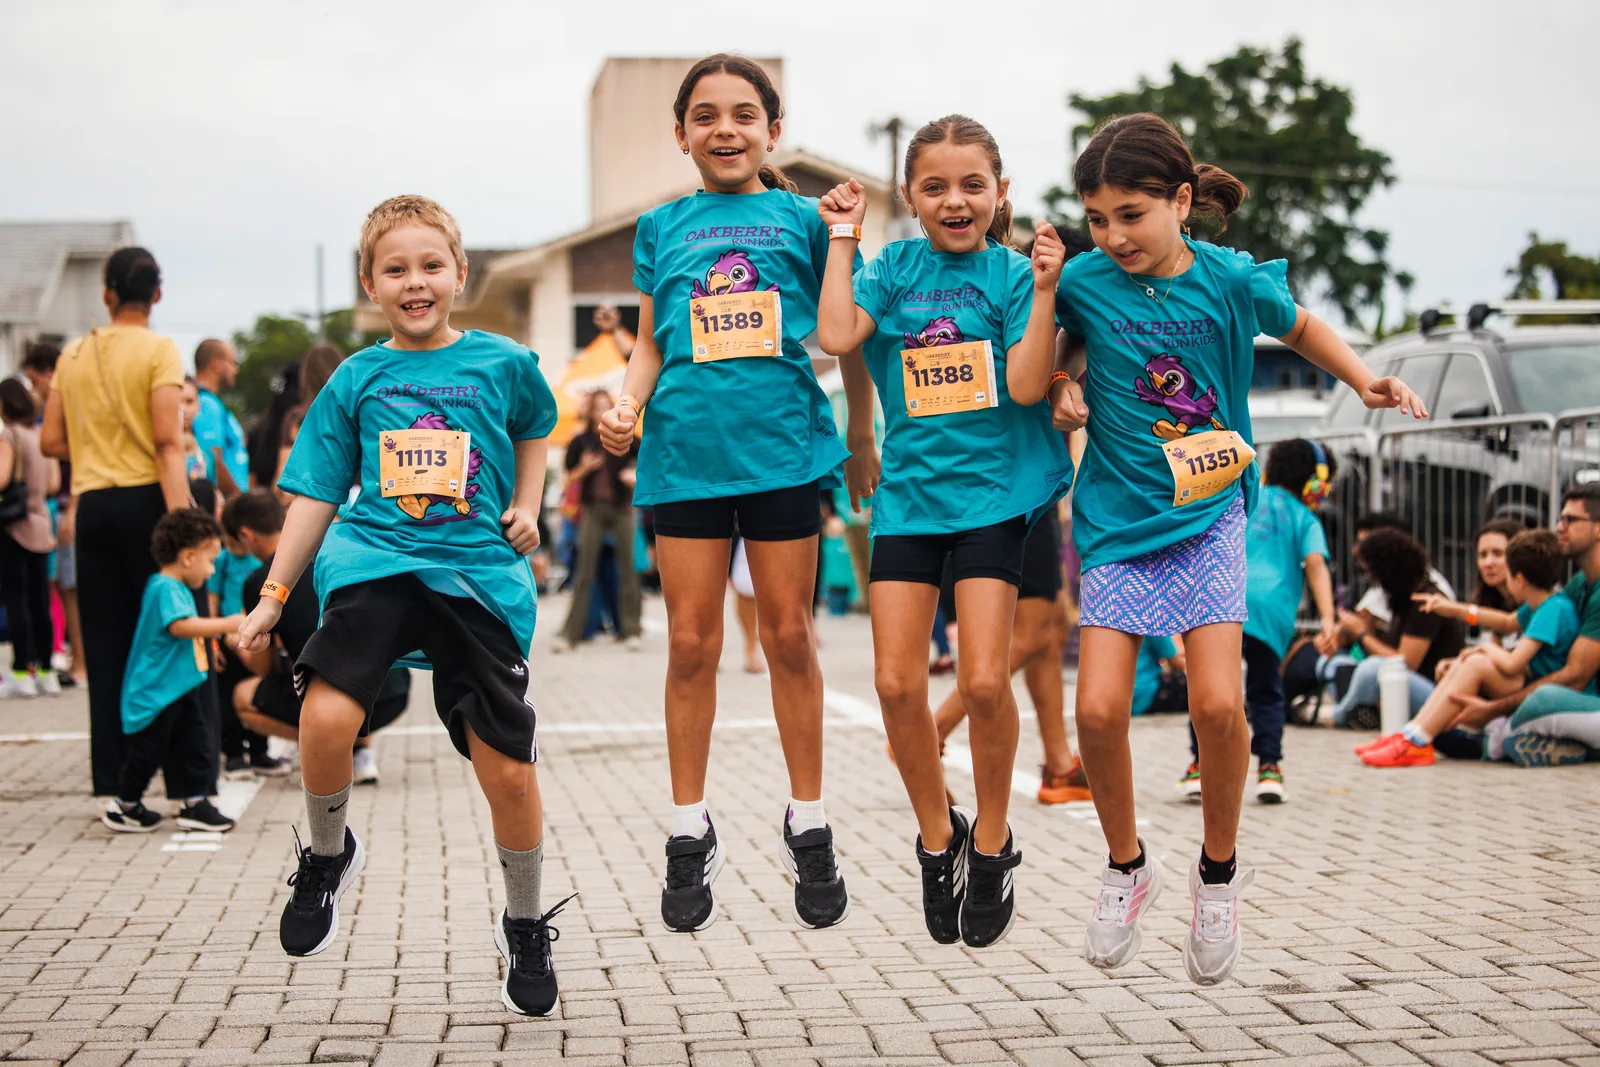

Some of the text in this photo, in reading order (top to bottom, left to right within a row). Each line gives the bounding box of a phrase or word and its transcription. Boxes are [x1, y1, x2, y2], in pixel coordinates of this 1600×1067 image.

[685, 226, 785, 242] OAKBERRY
[700, 311, 763, 334] 11389
[1110, 318, 1215, 336] OAKBERRY
[912, 364, 974, 387] 11388
[376, 383, 480, 400] OAKBERRY
[396, 450, 447, 467] 11113
[1187, 447, 1239, 475] 11351
